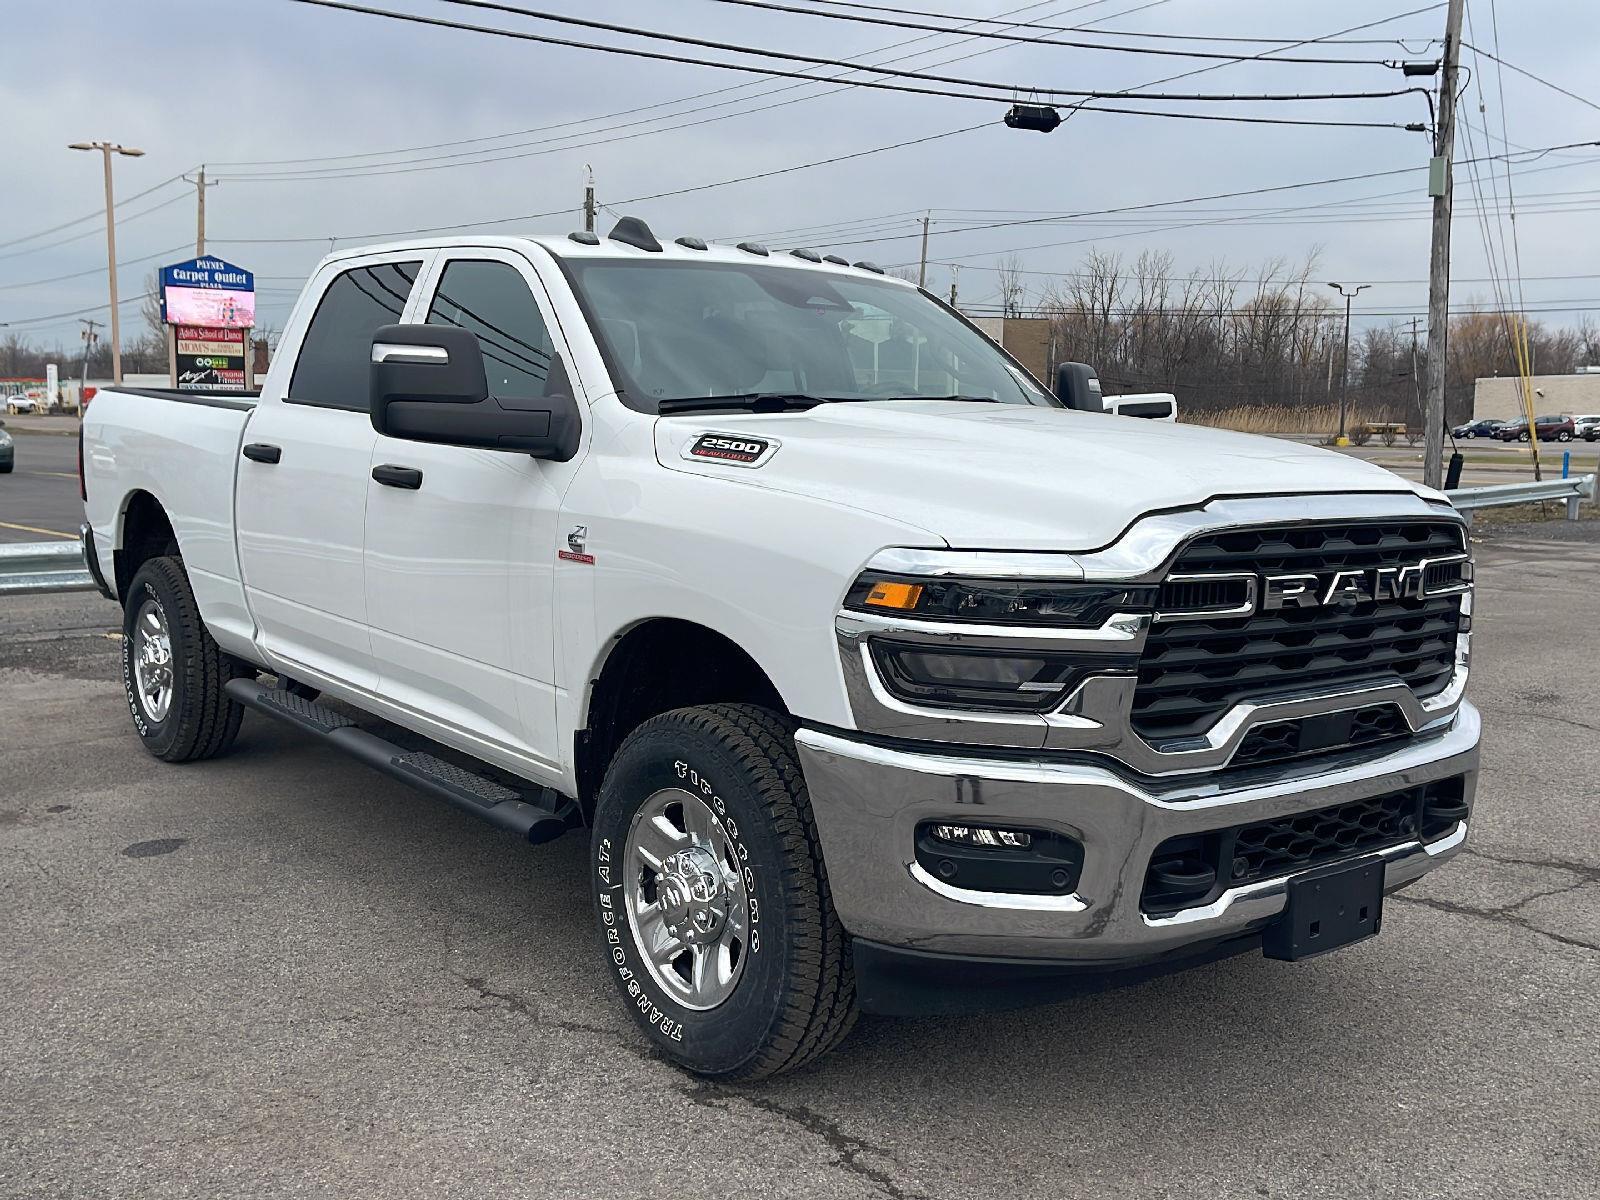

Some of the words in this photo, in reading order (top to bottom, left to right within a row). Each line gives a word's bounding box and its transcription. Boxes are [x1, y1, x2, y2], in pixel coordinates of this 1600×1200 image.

[173, 268, 209, 283] Carpet
[214, 272, 247, 284] Outlet
[212, 369, 244, 378] Personal
[695, 449, 726, 457] HEAVY
[702, 438, 760, 453] 2500
[1265, 567, 1423, 609] RAM
[598, 837, 612, 884] AT2
[600, 892, 684, 1042] TRANSFORCE
